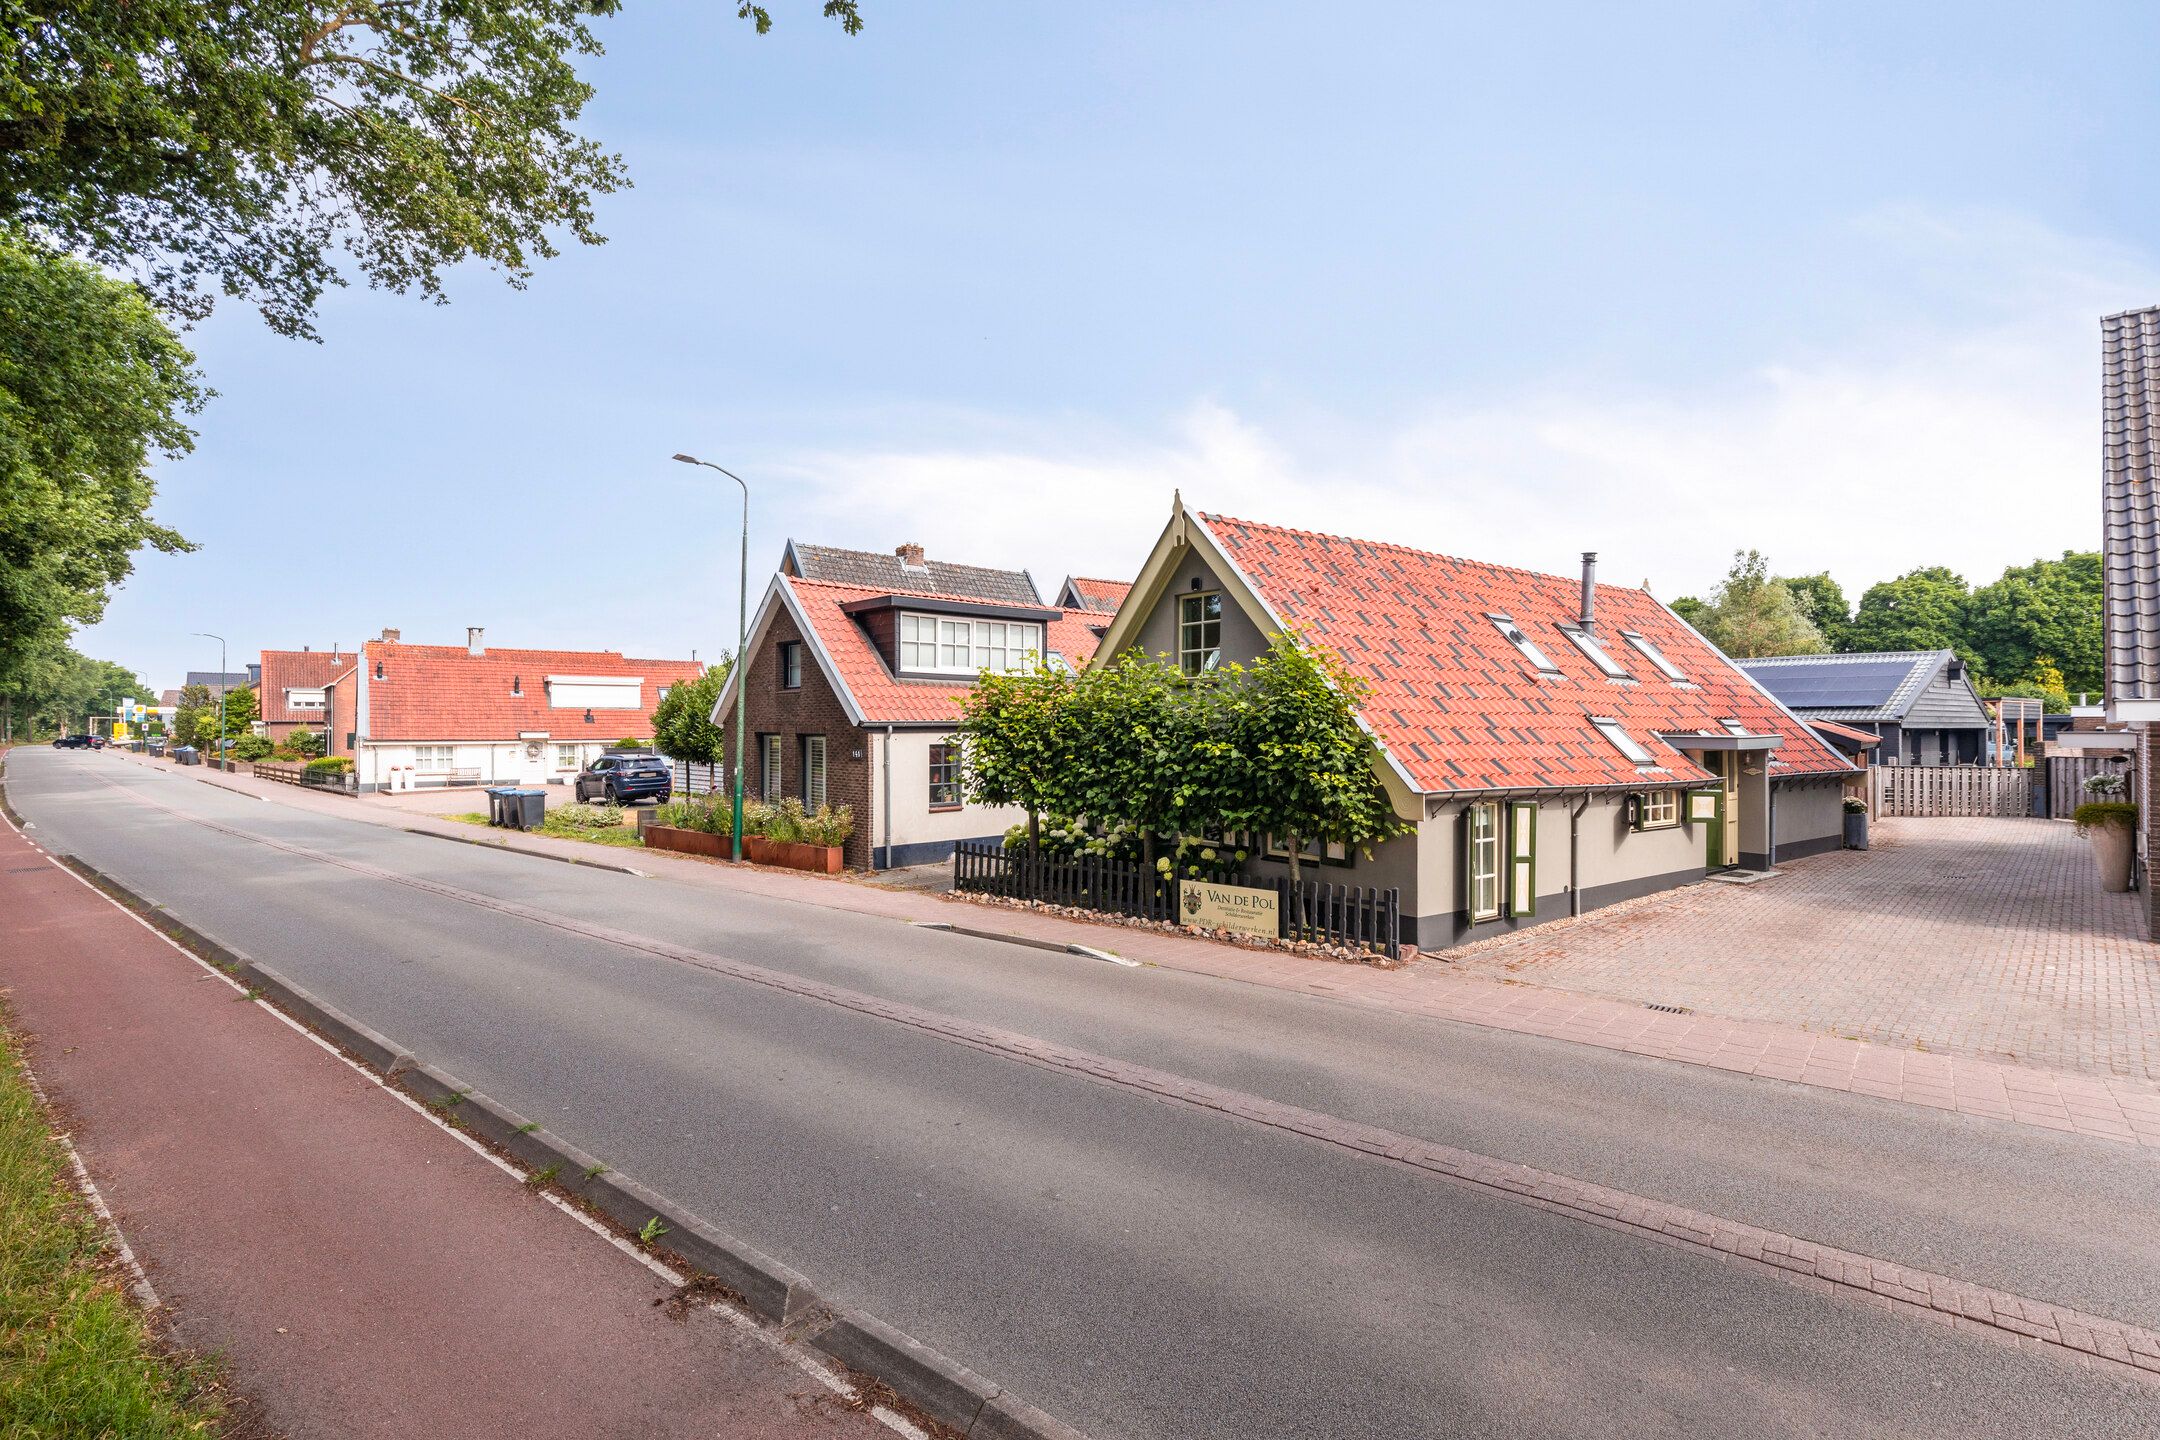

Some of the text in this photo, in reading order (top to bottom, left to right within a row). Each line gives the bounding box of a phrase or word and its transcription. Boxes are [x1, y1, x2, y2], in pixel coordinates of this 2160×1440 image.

[1207, 889, 1275, 910] VAN DE POL
